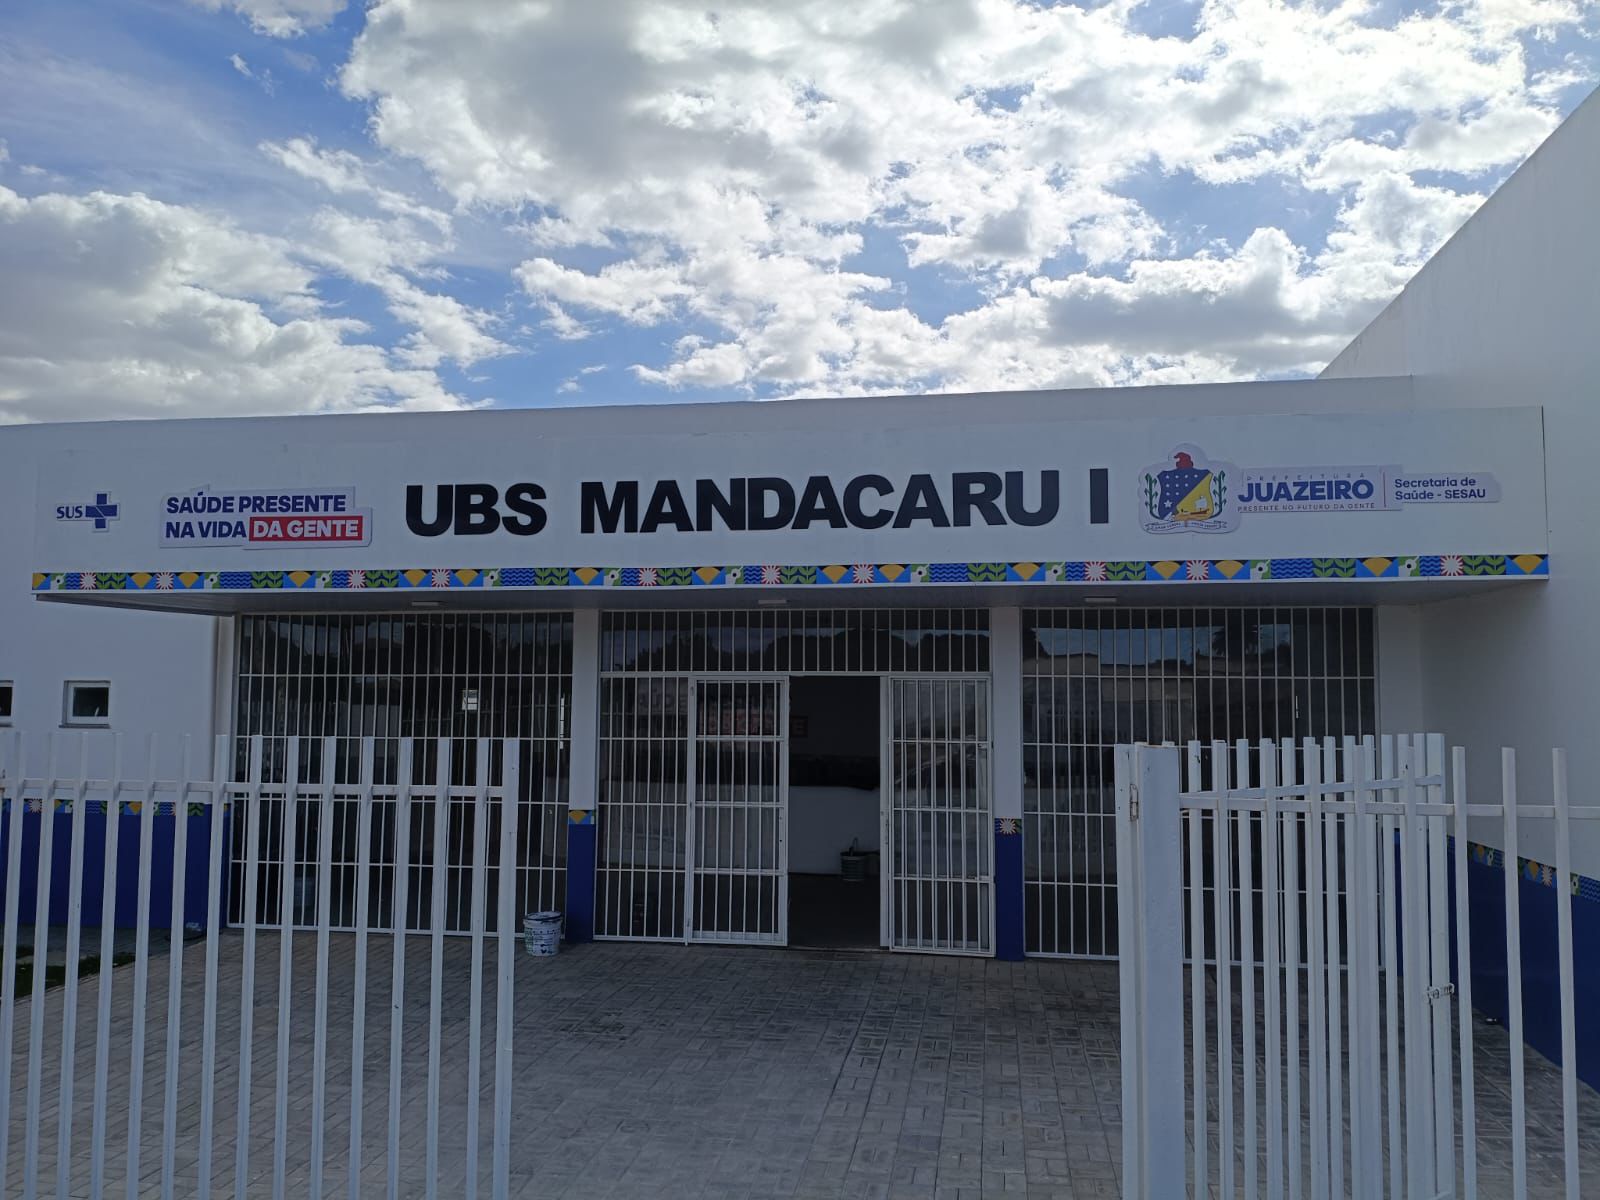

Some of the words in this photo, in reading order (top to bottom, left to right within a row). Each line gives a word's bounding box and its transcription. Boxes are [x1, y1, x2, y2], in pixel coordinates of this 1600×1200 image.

[1394, 477, 1458, 488] Secretaria
[1461, 476, 1476, 487] de
[1238, 479, 1374, 503] JUAZEIRO
[1395, 489, 1434, 501] Saúde
[1444, 489, 1486, 500] SESAU
[166, 491, 234, 514] SAÚDE
[238, 495, 346, 513] PRESENTE
[405, 484, 547, 537] UBS
[580, 470, 1060, 534] MANDACARU
[1090, 468, 1109, 524] I
[1237, 504, 1279, 512] PRESENTE
[56, 505, 83, 519] SUS
[165, 522, 195, 538] NA
[198, 521, 247, 538] VIDA
[253, 520, 283, 538] DA
[287, 519, 359, 538] GENTE
